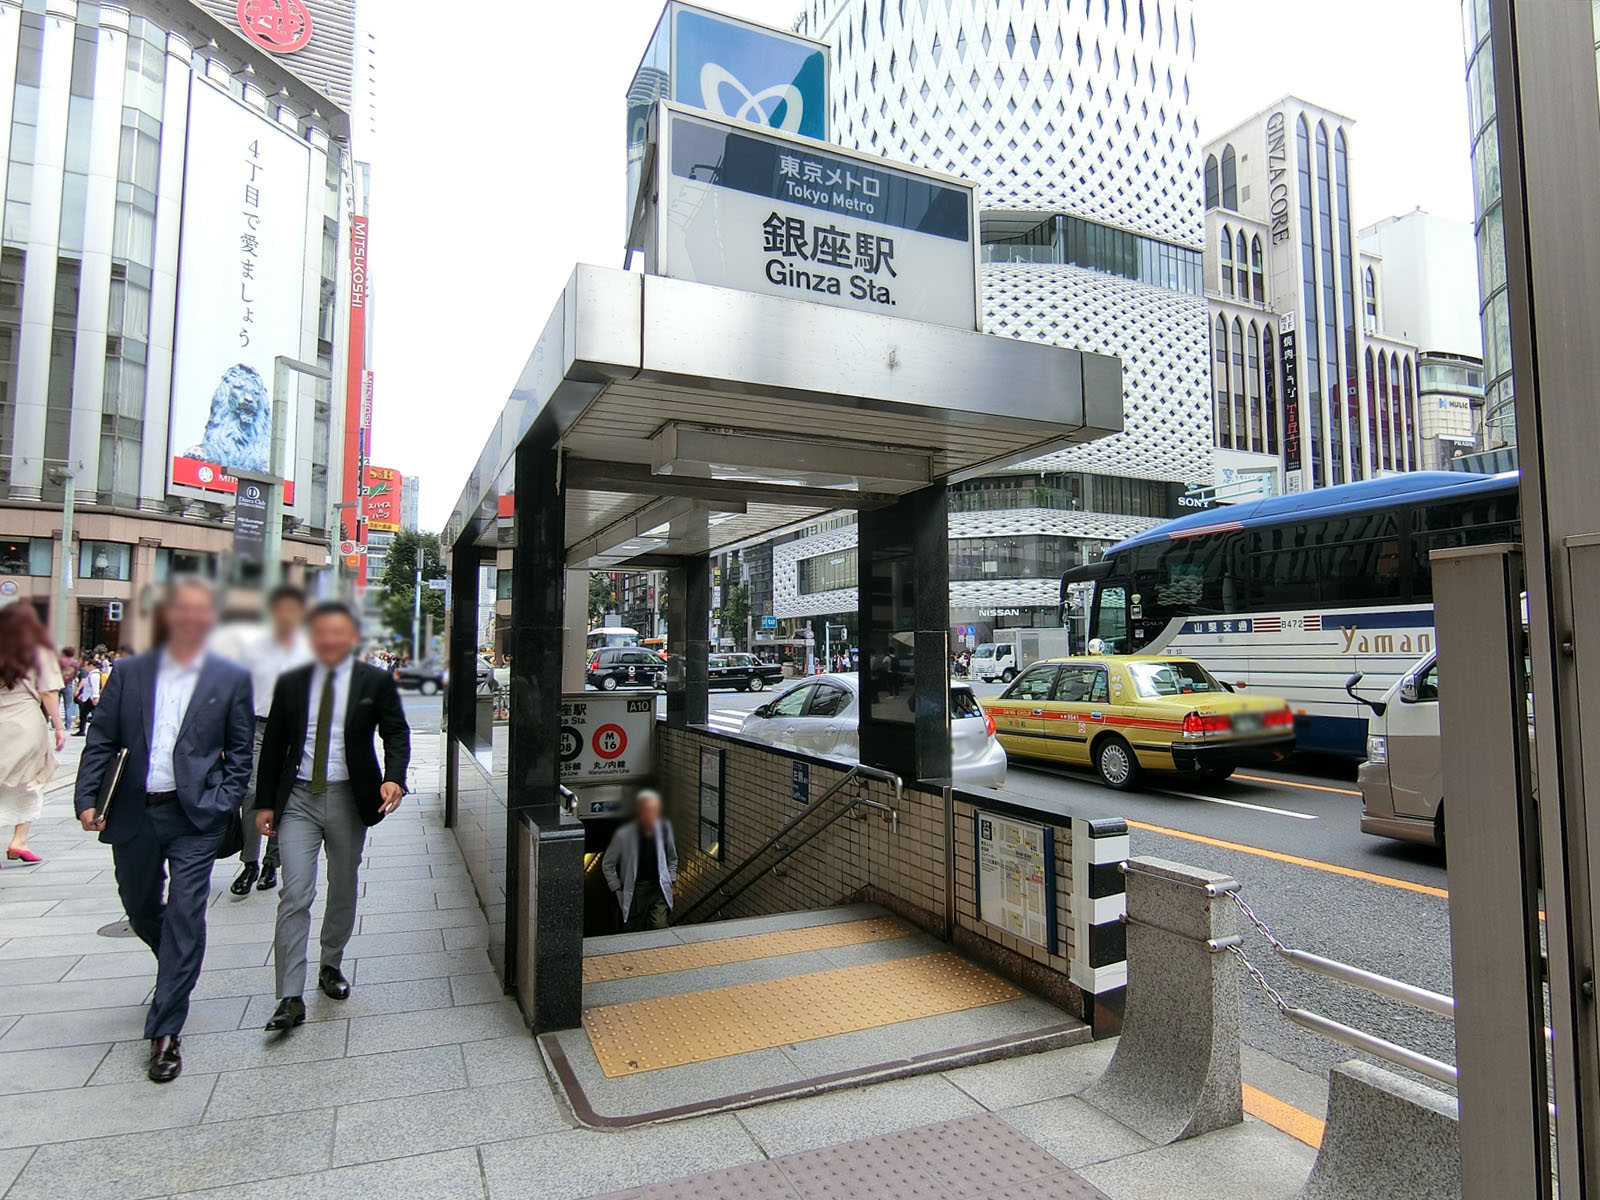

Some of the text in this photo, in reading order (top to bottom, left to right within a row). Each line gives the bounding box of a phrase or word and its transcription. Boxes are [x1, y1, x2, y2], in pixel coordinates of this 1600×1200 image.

[779, 154, 881, 198] 東京メトロ
[1267, 111, 1290, 246] GINZA CORE
[785, 180, 875, 214] Tokyo Metro
[239, 138, 265, 349] 4丁目で愛ましょう
[762, 211, 898, 278] 銀座駅
[352, 222, 367, 308] MITSUKOSHI
[765, 259, 897, 306] Ginza Sta.
[1178, 496, 1209, 508] SONY
[1281, 620, 1303, 629] B472
[629, 702, 649, 711] A10
[604, 741, 617, 750] 16
[606, 732, 614, 740] M
[593, 760, 626, 769] 丸ノ内線
